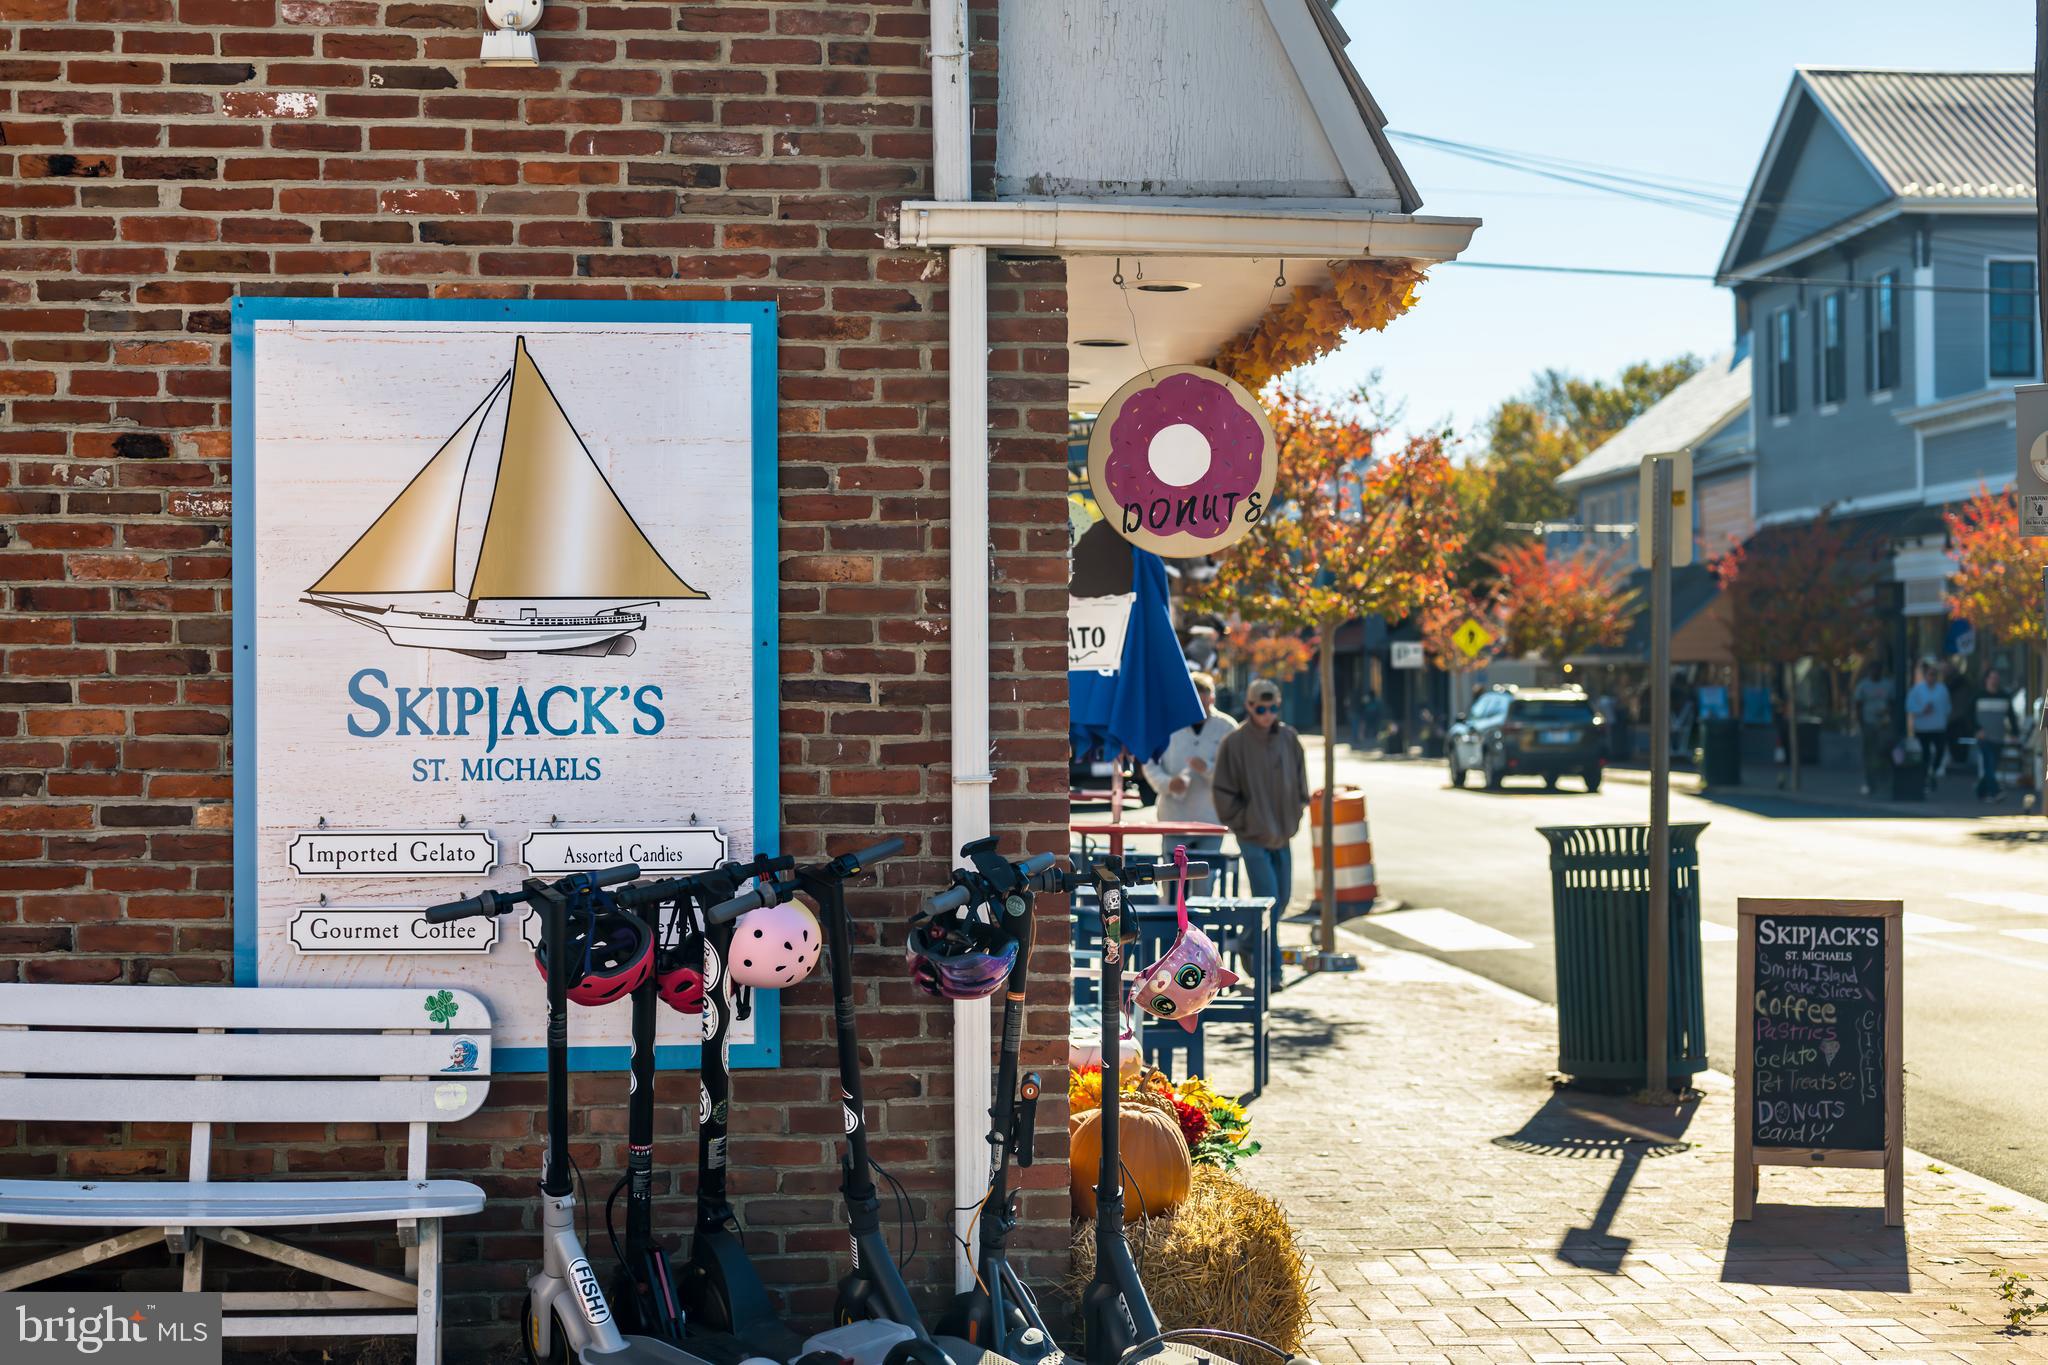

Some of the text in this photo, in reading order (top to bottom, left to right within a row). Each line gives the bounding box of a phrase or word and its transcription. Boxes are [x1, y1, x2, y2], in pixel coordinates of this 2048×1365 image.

[347, 668, 665, 753] SKIPJACK'S
[412, 757, 601, 782] ST. MICHAELS
[308, 841, 476, 869] Imported Gelato
[564, 843, 683, 864] Assorted Candies
[310, 918, 476, 939] Gourmet Coffee
[1759, 920, 1879, 950] SKIPJACK'S
[1760, 953, 1858, 985] Smith Island
[1785, 951, 1853, 961] ST. MICHAELS
[1755, 989, 1837, 1023] Coffee
[1755, 1044, 1817, 1067] Gelato
[1757, 1069, 1836, 1096] Pet Treats
[576, 1266, 606, 1317] FISH!
